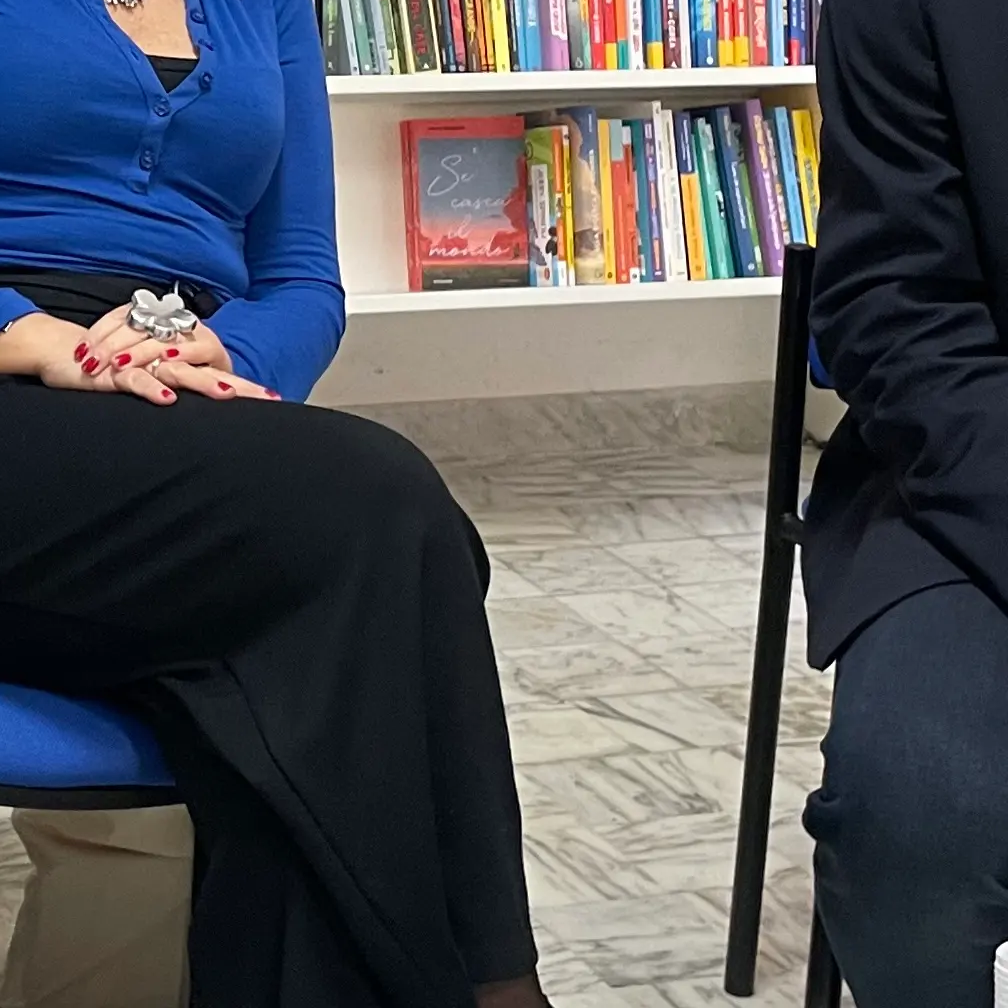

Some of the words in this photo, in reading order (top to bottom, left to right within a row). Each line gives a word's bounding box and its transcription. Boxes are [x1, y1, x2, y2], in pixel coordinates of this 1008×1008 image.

[427, 154, 474, 197] Se
[450, 197, 511, 210] casca
[429, 242, 510, 258] mondo
